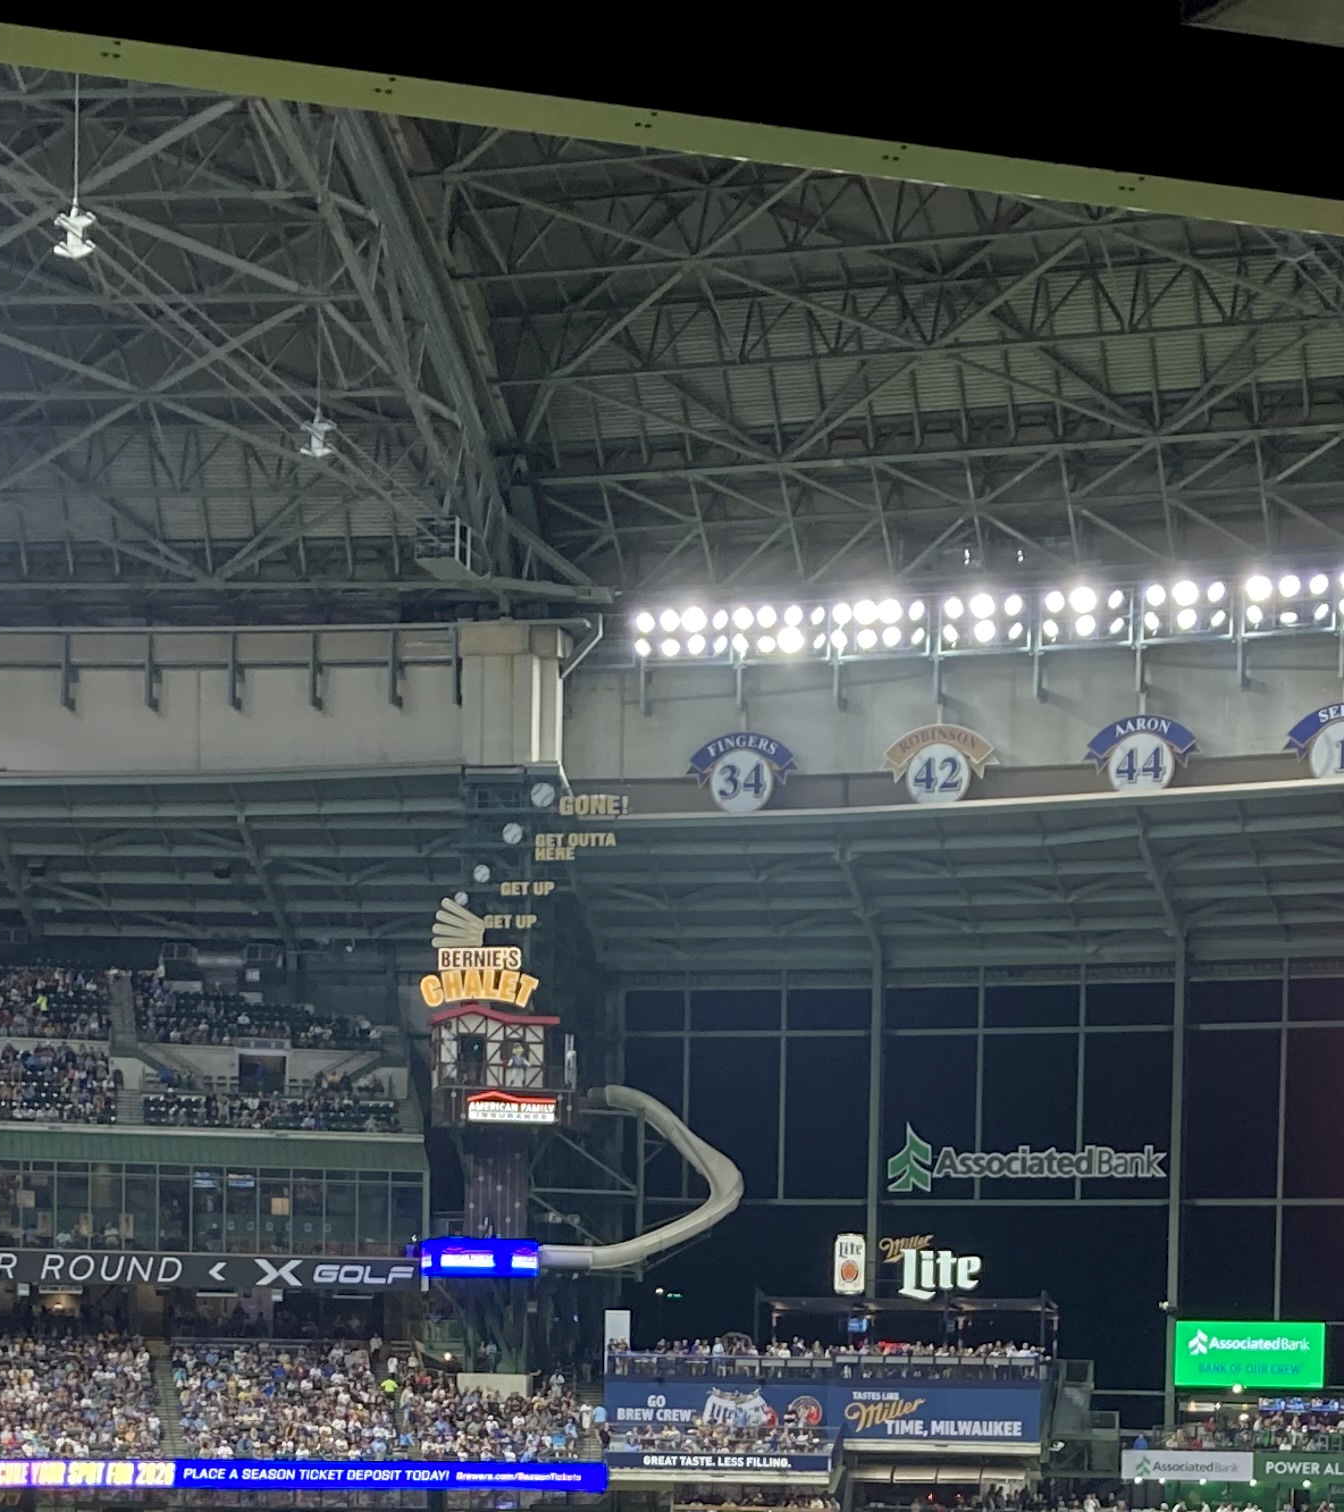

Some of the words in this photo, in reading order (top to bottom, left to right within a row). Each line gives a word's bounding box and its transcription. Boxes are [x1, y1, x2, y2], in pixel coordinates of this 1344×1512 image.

[1115, 718, 1171, 736] AARON
[706, 734, 778, 757] FINGERS
[899, 728, 978, 753] ROBINSON
[1116, 747, 1165, 783] 44
[718, 763, 766, 799] 34
[913, 757, 961, 793] 42
[559, 795, 629, 815] GONE!
[536, 833, 563, 847] GET
[568, 833, 616, 847] OUTTA
[535, 848, 575, 861] HERE
[501, 882, 531, 896] GET
[533, 882, 554, 896] UP
[484, 915, 512, 929] GET
[516, 914, 537, 929] UP
[441, 949, 519, 968] BERNIE'S
[420, 969, 539, 1007] CHALET
[879, 1234, 934, 1263] Miller
[40, 1255, 184, 1283] ROUND
[255, 1259, 303, 1287] X
[313, 1265, 415, 1284] GOLF
[898, 1249, 982, 1300] Lite
[647, 1395, 666, 1408] GO
[617, 1408, 655, 1421] BREW
[656, 1409, 692, 1422] CREW
[844, 1398, 926, 1433] Miller
[885, 1420, 928, 1437] TIME,
[931, 1421, 1022, 1437] MILWAUKEE
[643, 1455, 677, 1465] GREAT
[679, 1456, 715, 1466] TASTE.
[718, 1457, 744, 1467] LESS
[746, 1457, 792, 1468] FILLING.
[1266, 1461, 1320, 1475] POWER
[184, 1468, 226, 1479] PLACE
[242, 1469, 296, 1480] SEASON
[300, 1469, 342, 1480] TICKET
[346, 1469, 401, 1481] DEPOSIT
[405, 1470, 449, 1480] TODAY!
